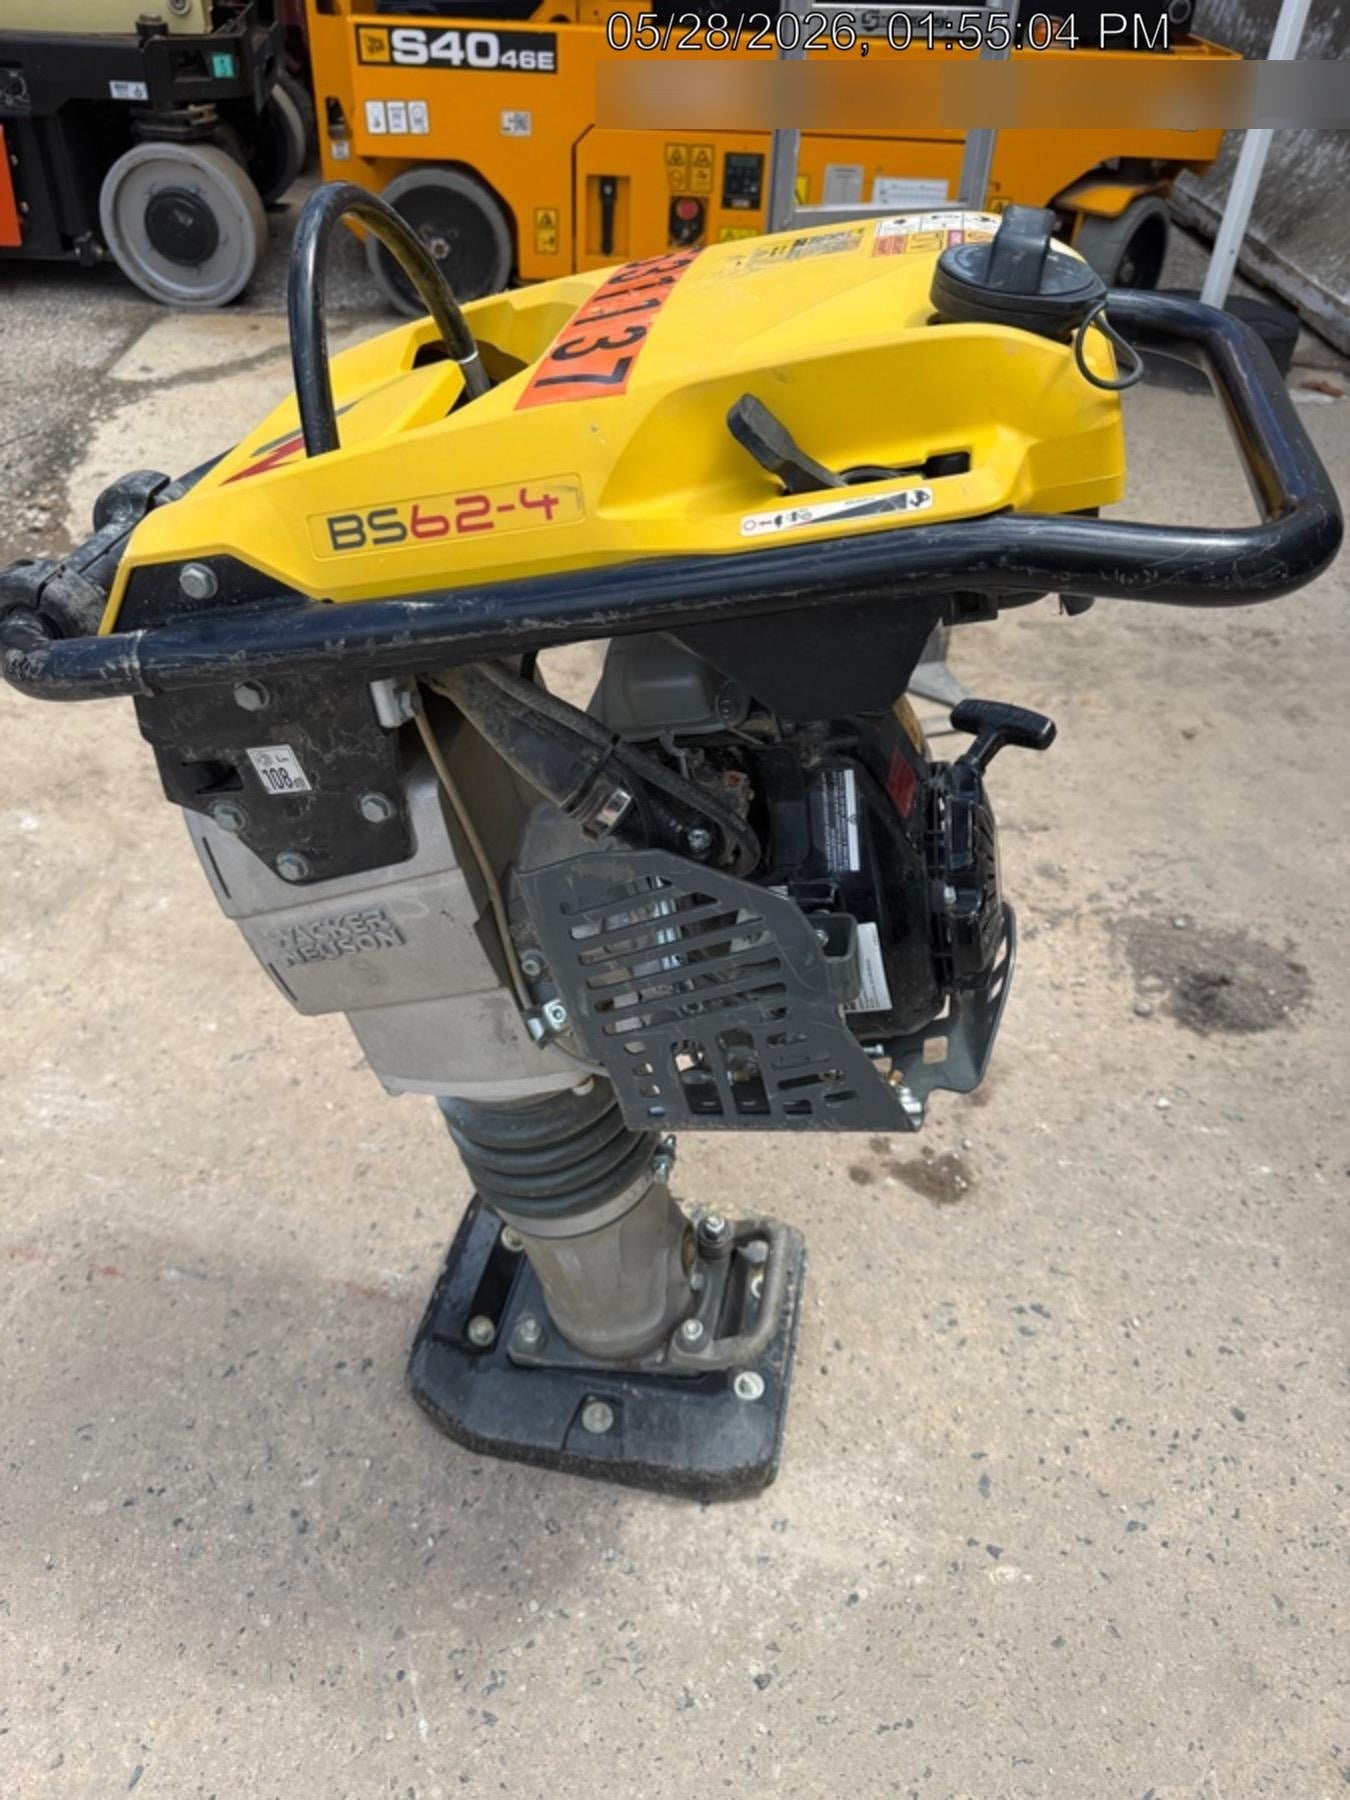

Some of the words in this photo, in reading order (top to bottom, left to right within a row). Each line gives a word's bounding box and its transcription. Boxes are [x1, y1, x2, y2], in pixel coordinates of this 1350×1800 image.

[391, 29, 499, 67] S40
[501, 50, 555, 70] 46E
[327, 487, 560, 551] BS62-4
[261, 767, 293, 790] 108
